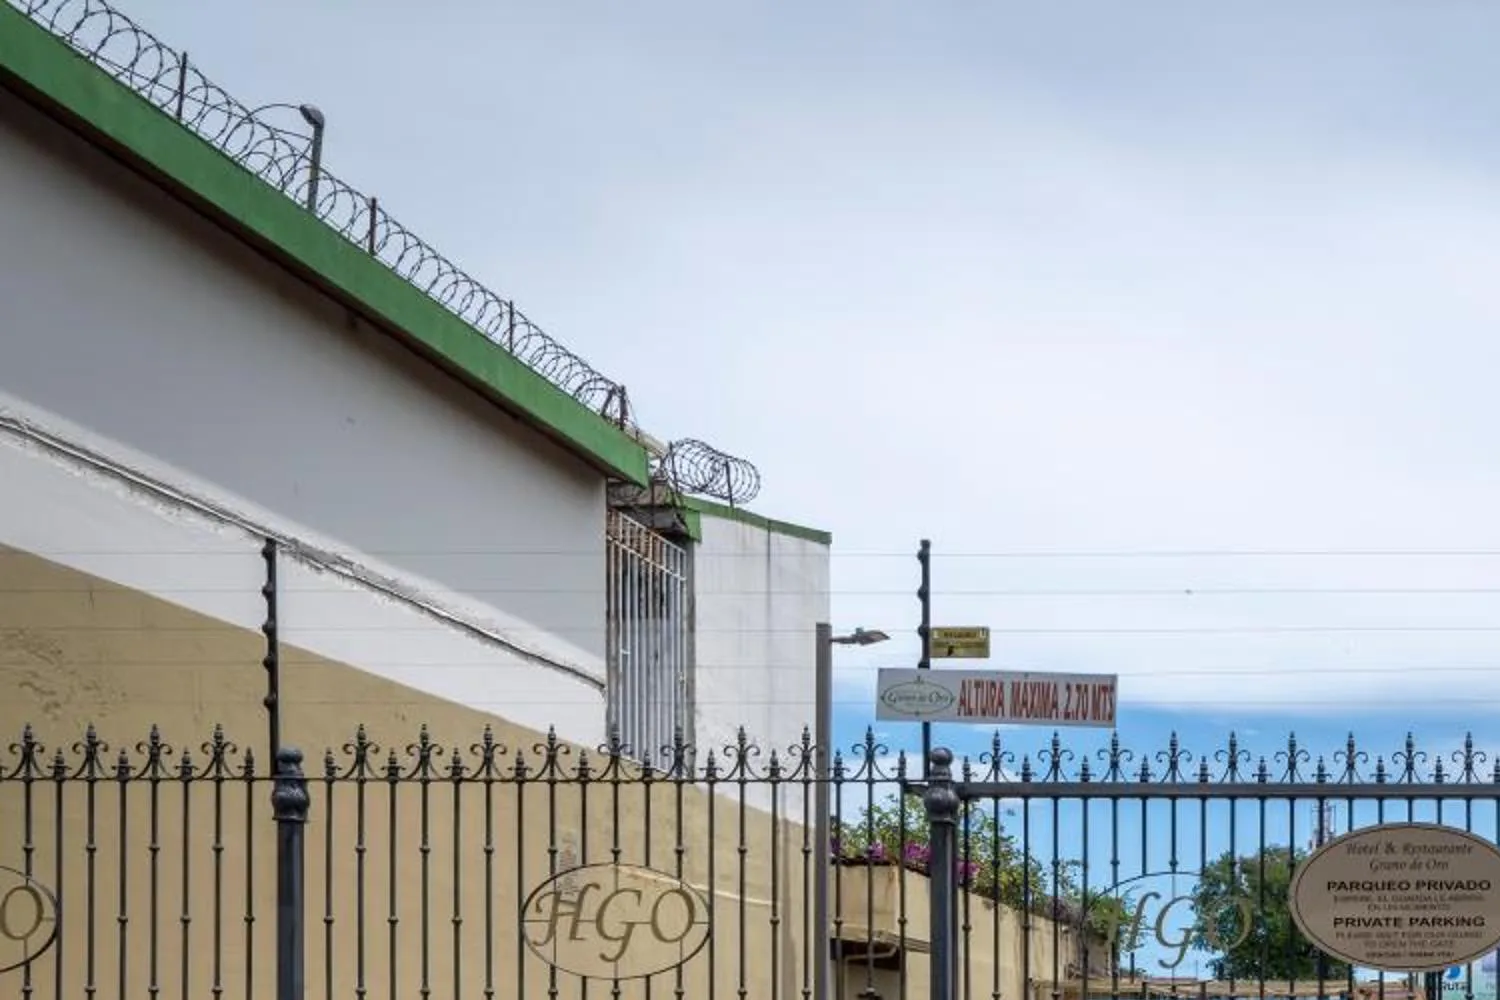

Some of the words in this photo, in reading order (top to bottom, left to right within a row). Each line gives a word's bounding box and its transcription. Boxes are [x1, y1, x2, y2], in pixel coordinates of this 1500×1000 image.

[957, 679, 1005, 718] ALTURA
[1346, 842, 1379, 855] Hotel
[1384, 841, 1396, 855] &
[1409, 858, 1422, 870] de
[1425, 859, 1449, 870] Oro
[1327, 879, 1410, 891] PARQUEO
[1415, 879, 1491, 891] PRIVADO
[532, 882, 696, 963] HGO
[1333, 916, 1402, 928] PRIVATE
[1409, 916, 1486, 928] PARKING
